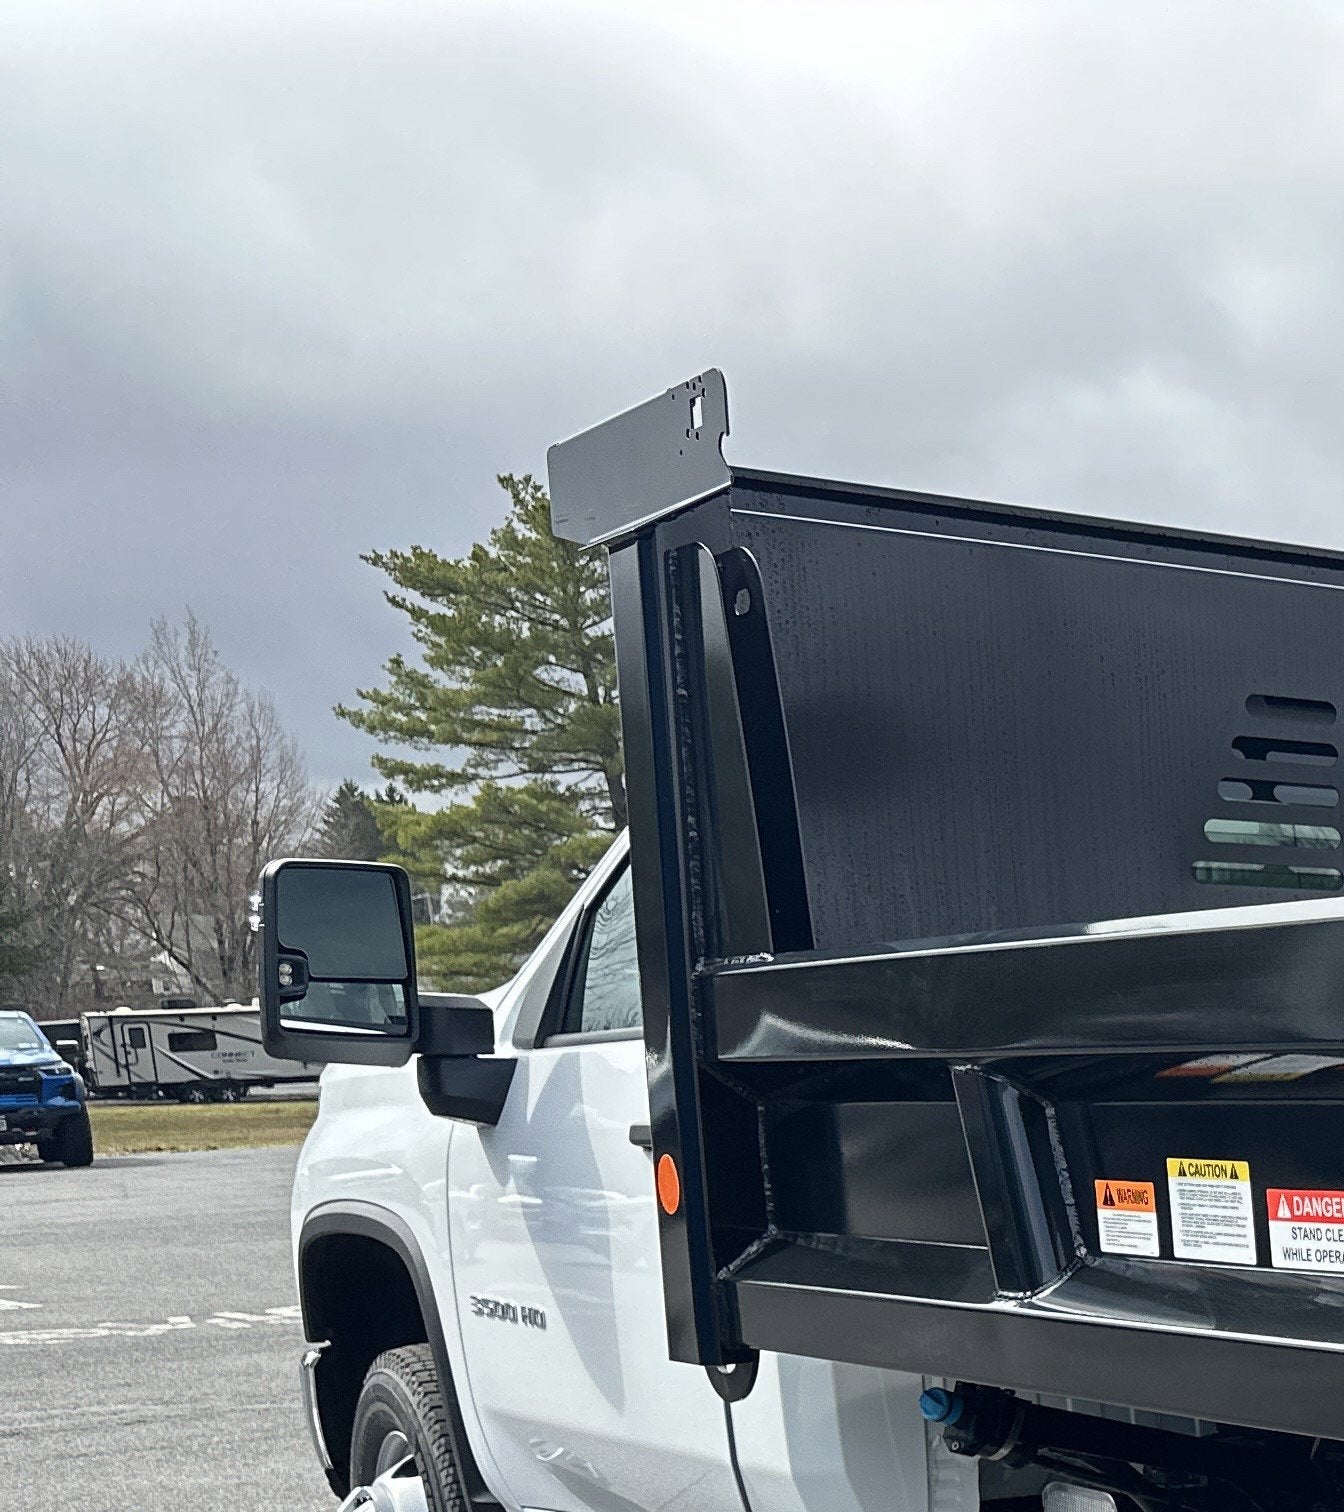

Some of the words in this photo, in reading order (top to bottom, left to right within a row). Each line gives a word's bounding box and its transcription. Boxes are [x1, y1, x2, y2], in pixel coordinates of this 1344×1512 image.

[1187, 1163, 1228, 1179] CAUTION
[1115, 1187, 1149, 1206] WARNING
[1291, 1226, 1323, 1242] STAND
[1282, 1246, 1314, 1263] WHILE
[470, 1294, 519, 1324] 3500
